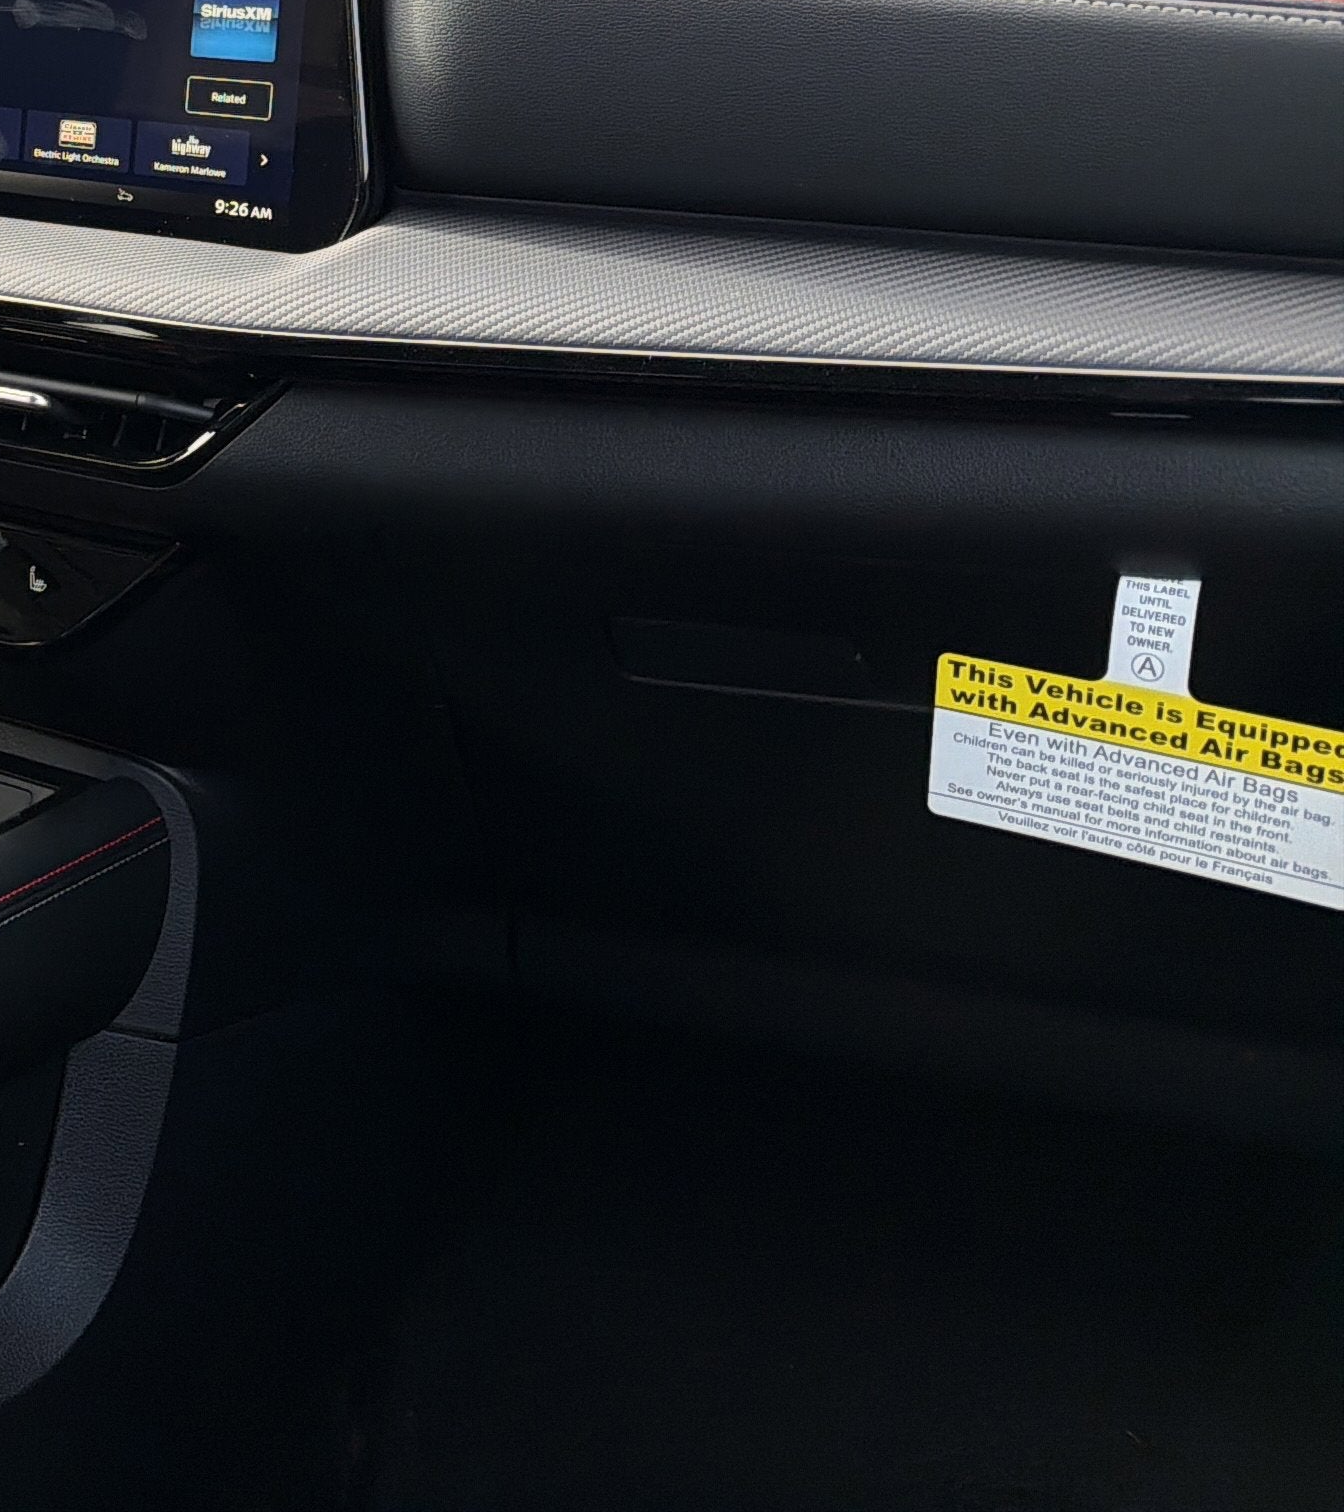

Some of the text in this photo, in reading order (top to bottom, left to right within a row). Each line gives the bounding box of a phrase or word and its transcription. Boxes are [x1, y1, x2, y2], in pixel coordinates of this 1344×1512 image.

[200, 3, 273, 22] SiriusXM
[211, 92, 247, 105] Related
[33, 148, 119, 167] Electric Light Orchestra
[171, 139, 211, 159] highway
[215, 199, 273, 221] 9:26 AM
[1125, 580, 1151, 592] THIS
[1153, 584, 1191, 599] LABEL
[1139, 595, 1173, 610] UNTIL
[1121, 605, 1187, 626] DELIVERED
[1130, 621, 1175, 639] TO NEW
[1127, 635, 1174, 654] OWNER.
[1137, 656, 1157, 678] A
[948, 659, 1014, 689] This
[1025, 674, 1144, 716] Vehicle
[1156, 701, 1183, 724] is
[951, 688, 1344, 785] with Advanced Air Bags
[988, 721, 1299, 804] Even with Advanced Air Bags
[953, 731, 1008, 753] Children
[1010, 746, 1036, 759] can
[1039, 750, 1056, 763] be
[1059, 754, 1095, 772] killed
[1098, 765, 1113, 776] or
[1117, 769, 1178, 791] seriously
[1181, 781, 1229, 802] injured
[1232, 792, 1250, 808] by
[1254, 797, 1278, 813] the
[1280, 805, 1299, 818] air
[986, 751, 1013, 767] The
[1016, 758, 1048, 775] back
[1051, 768, 1080, 782] seat
[1083, 773, 1095, 785] is
[1098, 777, 1121, 791] the
[1125, 783, 1166, 800] safest
[1169, 793, 1208, 811] place
[1211, 801, 1231, 815] for
[986, 764, 1293, 844] Never put a rear-facing child seat in the front.
[947, 782, 973, 797] See
[976, 790, 1028, 810] owner's
[1031, 802, 1081, 822] manual
[1084, 812, 1103, 826] for
[1107, 820, 1141, 836] more
[1144, 827, 1222, 855] information
[1225, 847, 1267, 865] about
[1269, 858, 1289, 870] air
[995, 780, 1279, 854] Always use seat belts and child restraints.
[997, 810, 1050, 832] Veuillez
[1053, 825, 1079, 839] voir
[1159, 850, 1192, 865] pour
[1195, 856, 1209, 869] le
[1212, 860, 1273, 885] Français
